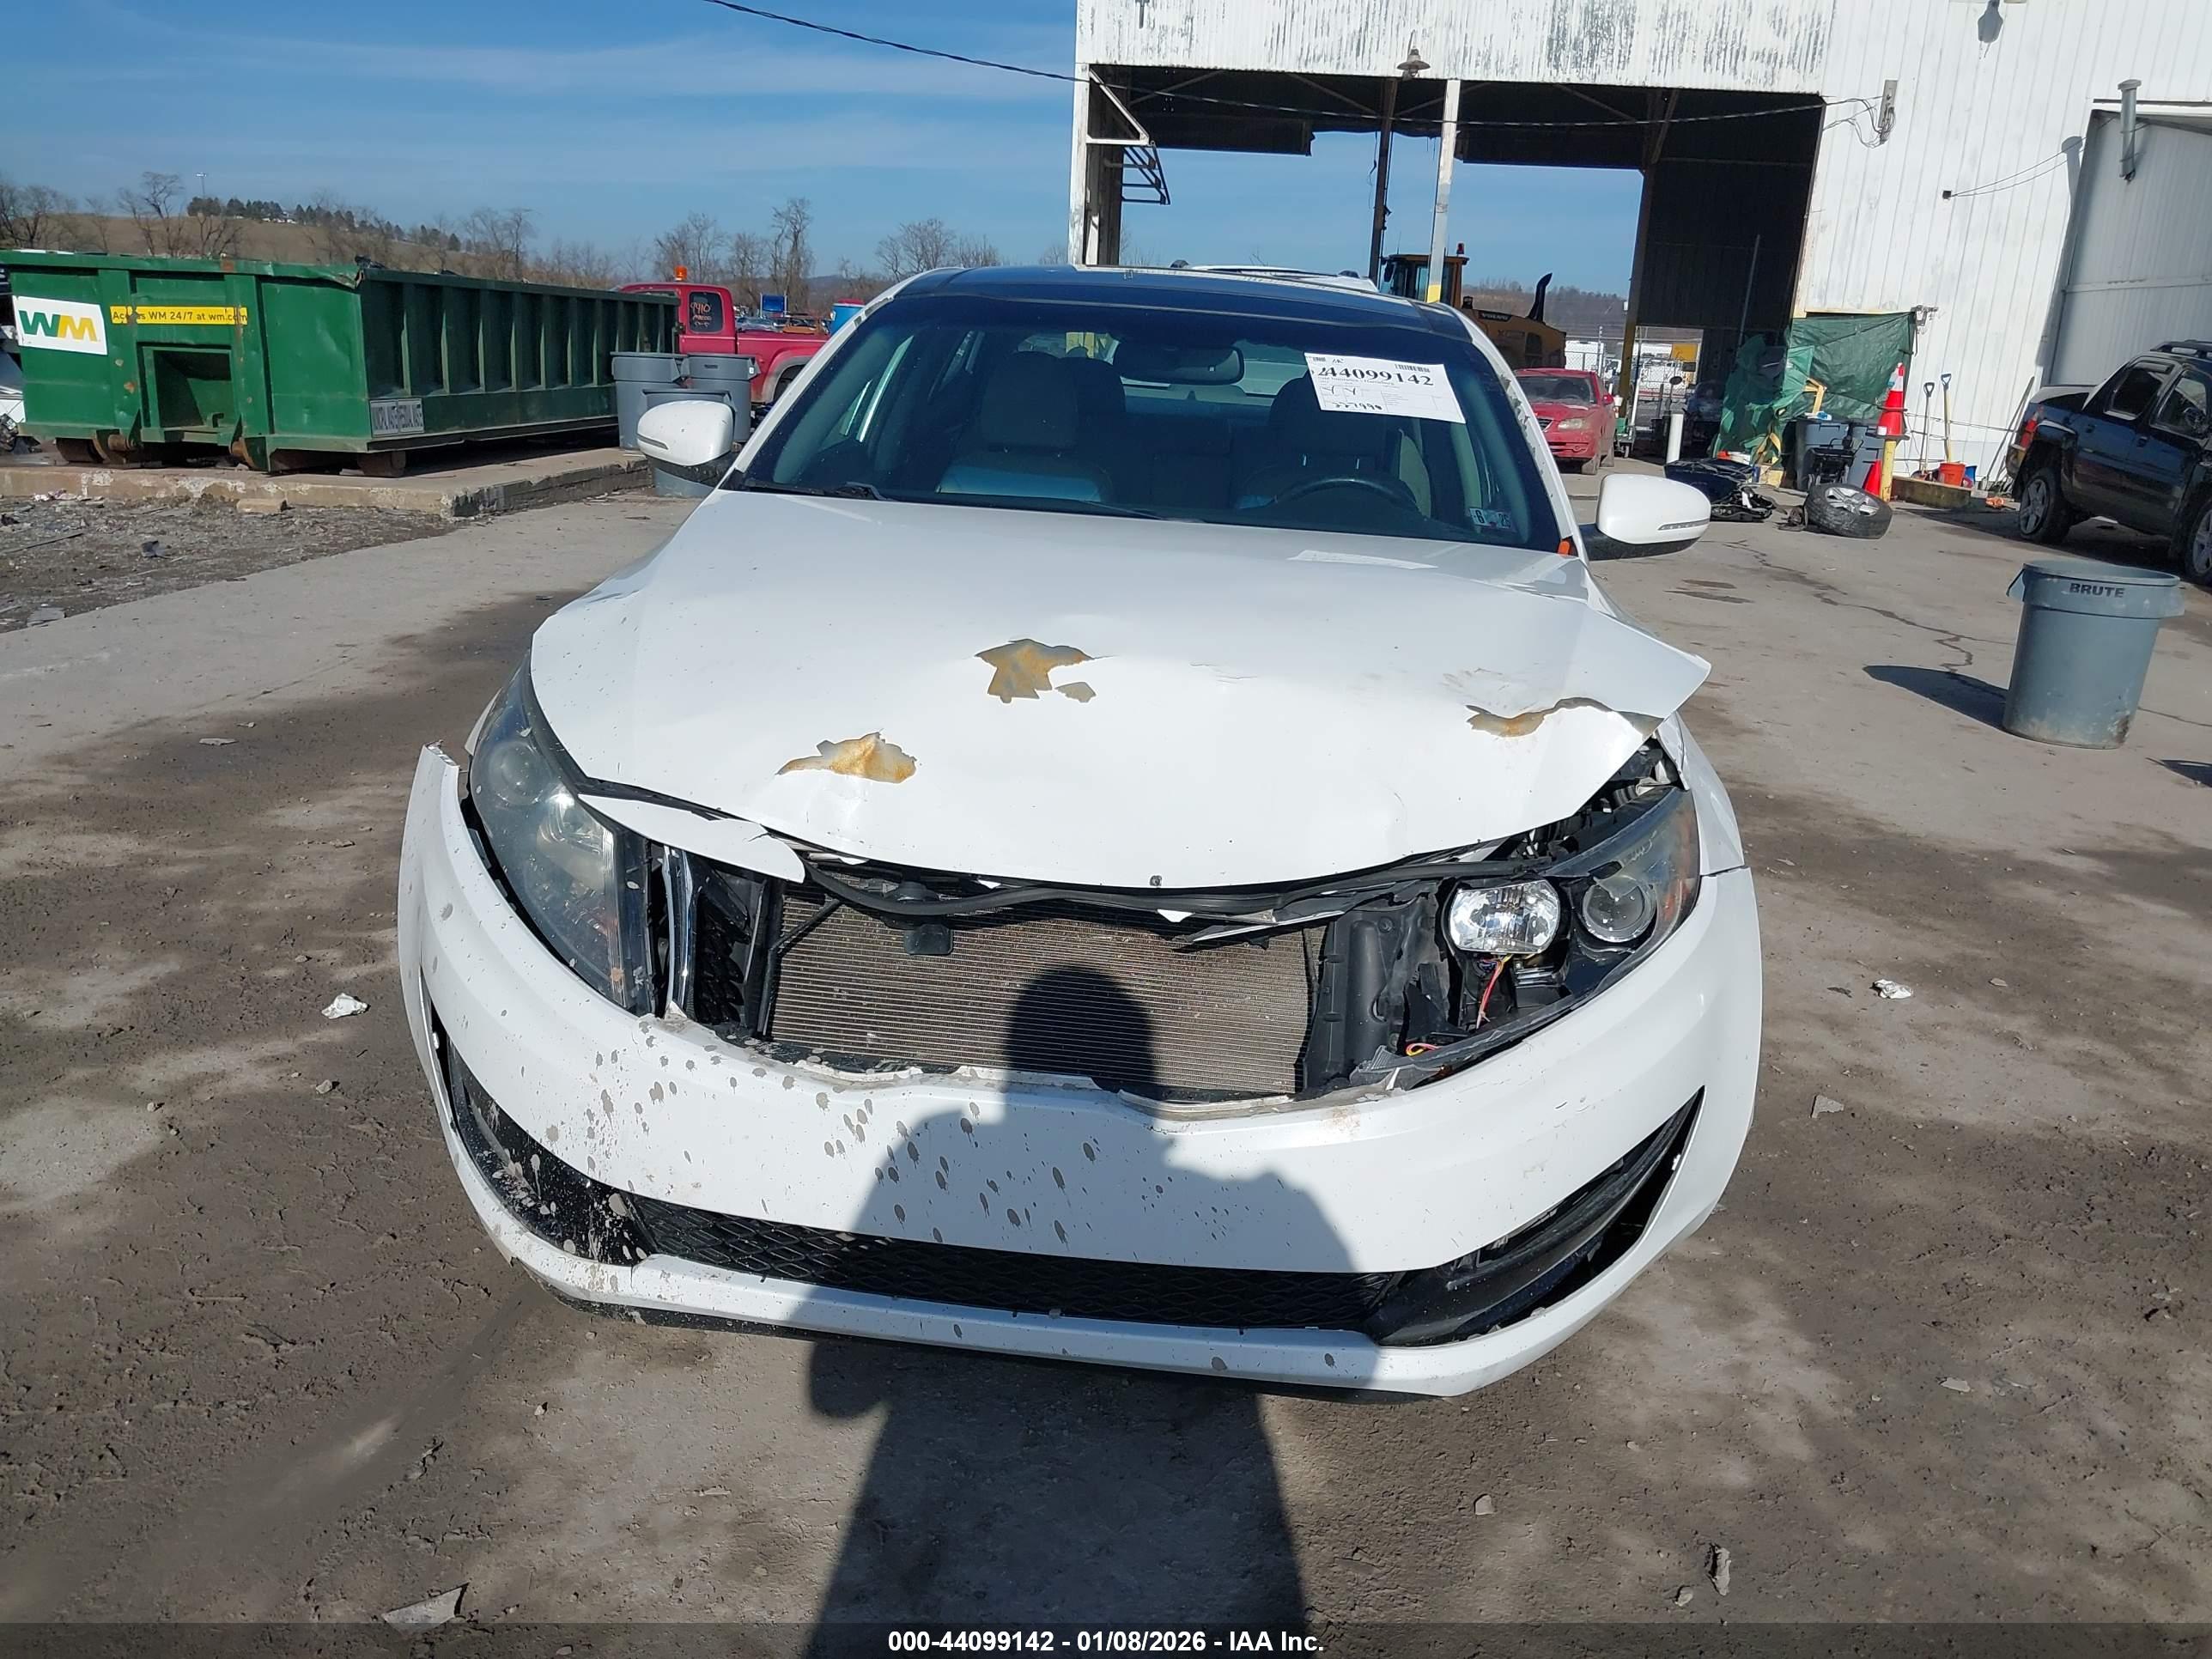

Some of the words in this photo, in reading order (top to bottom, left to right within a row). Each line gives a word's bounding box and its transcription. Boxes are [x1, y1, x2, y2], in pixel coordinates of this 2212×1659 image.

[149, 311, 167, 320] WM
[171, 311, 193, 320] 24/7
[18, 310, 98, 342] WM
[2069, 583, 2125, 599] BRUTE
